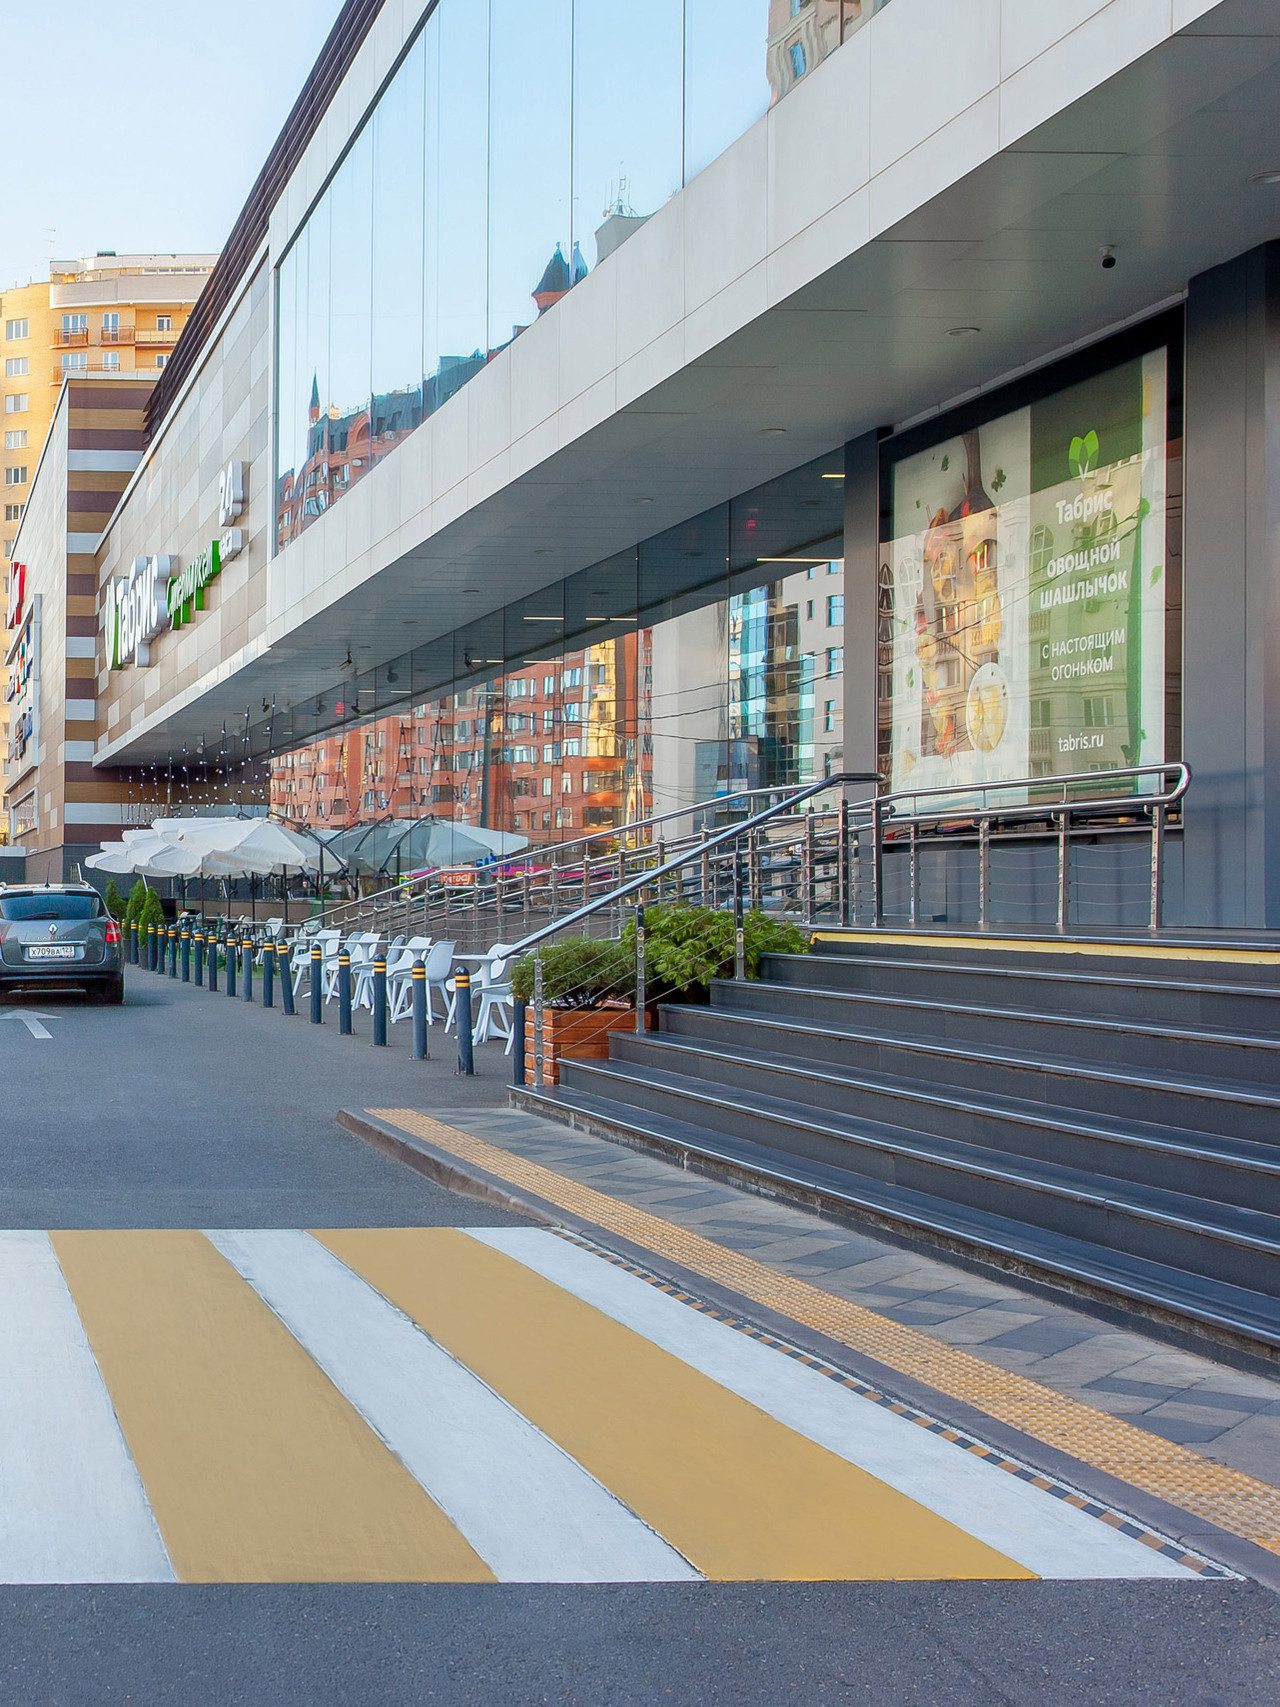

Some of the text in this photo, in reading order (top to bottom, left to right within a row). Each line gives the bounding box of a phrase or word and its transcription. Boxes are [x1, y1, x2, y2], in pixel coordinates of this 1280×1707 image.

[219, 460, 243, 527] 24
[1056, 490, 1113, 524] Табрис
[1047, 537, 1120, 578] ОВОЩНОЙ
[1040, 570, 1128, 609] ШАШЛЫЧОК
[116, 554, 172, 667] Табрис
[1042, 628, 1125, 659] С НАСТОЯЩИМ
[1051, 656, 1113, 681] ОГОНЬКОМ
[1058, 732, 1104, 752] tabris.ru
